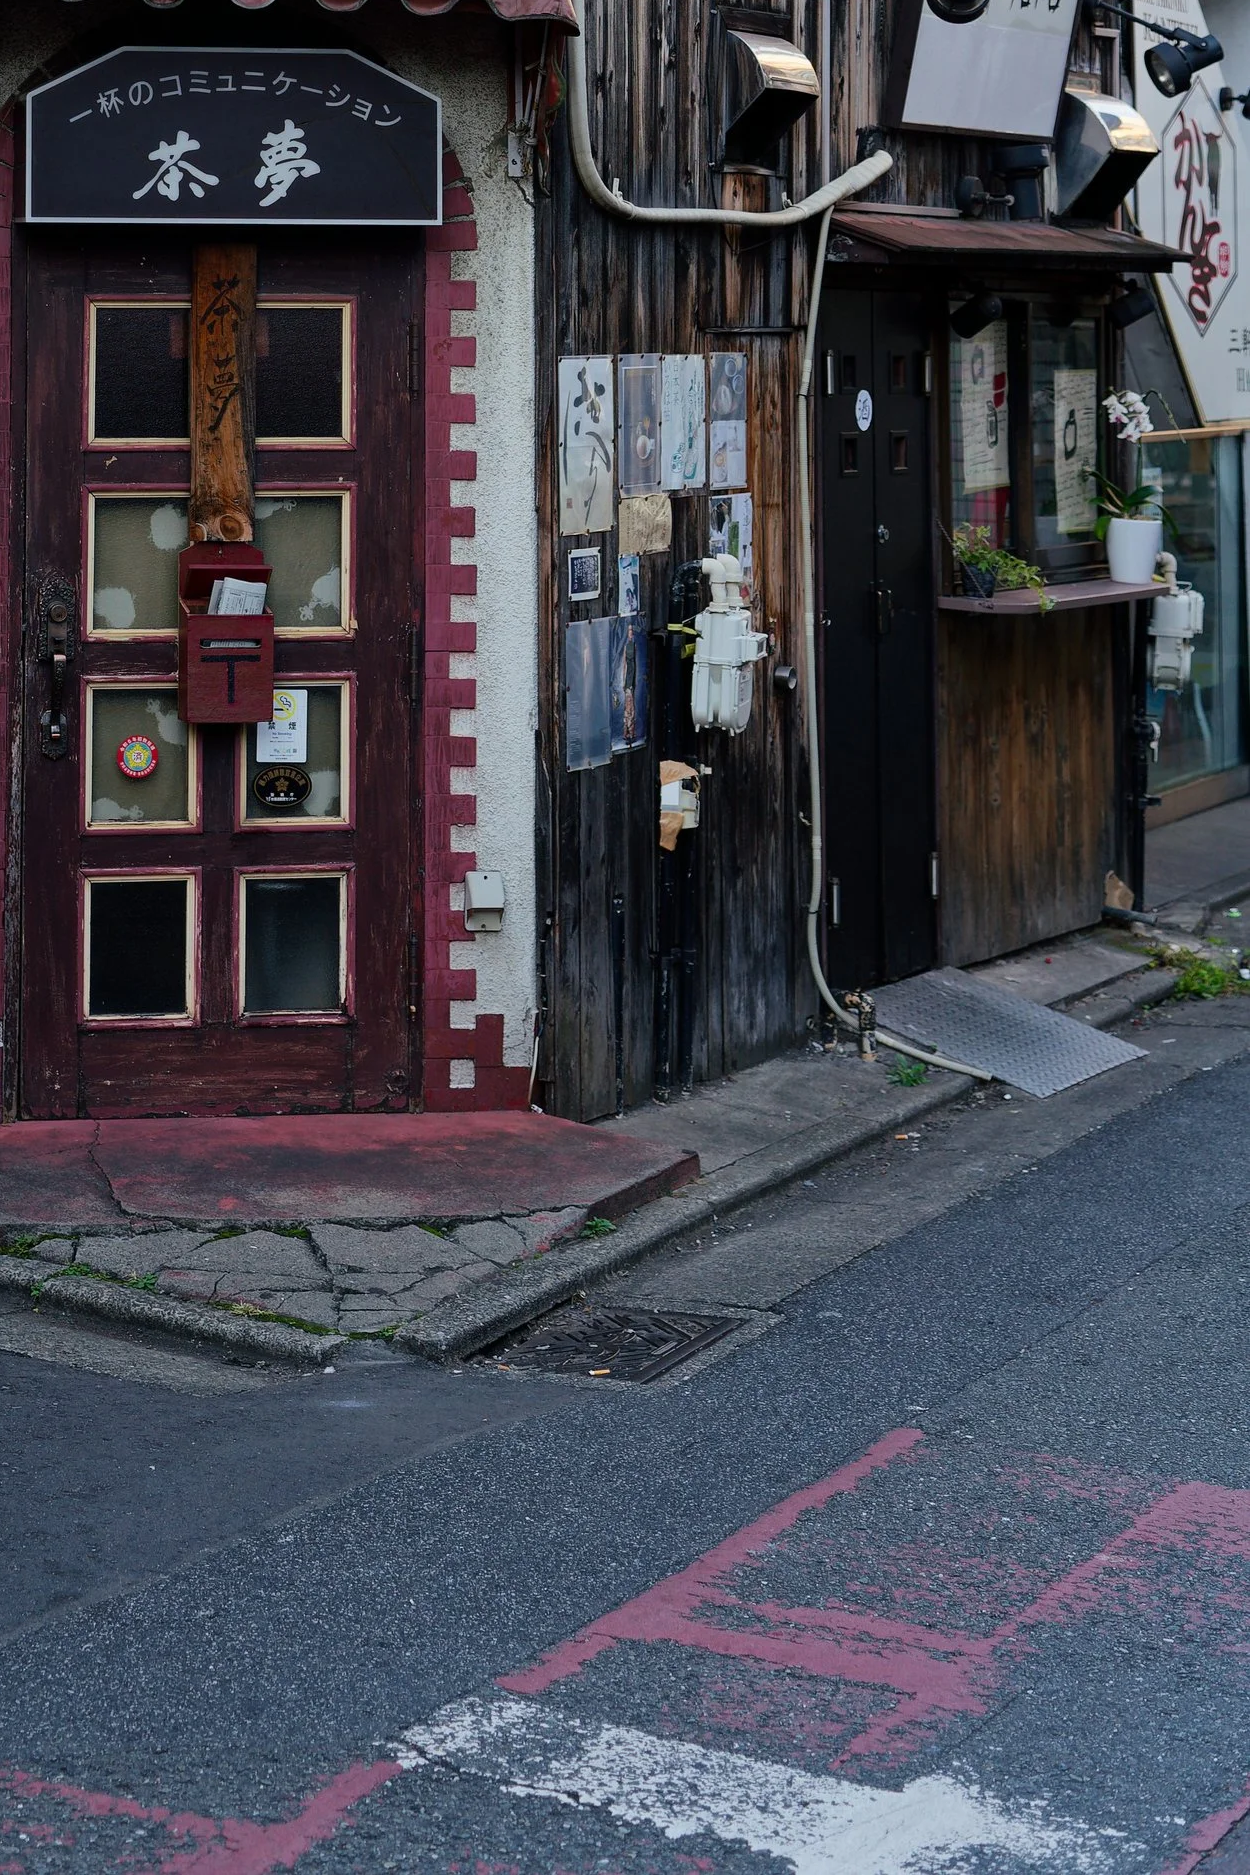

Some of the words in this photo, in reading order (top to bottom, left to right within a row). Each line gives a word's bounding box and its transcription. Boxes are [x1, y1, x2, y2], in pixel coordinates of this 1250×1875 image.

[68, 69, 403, 128] 一杯のコミュニケーション
[131, 118, 322, 208] 茶夢
